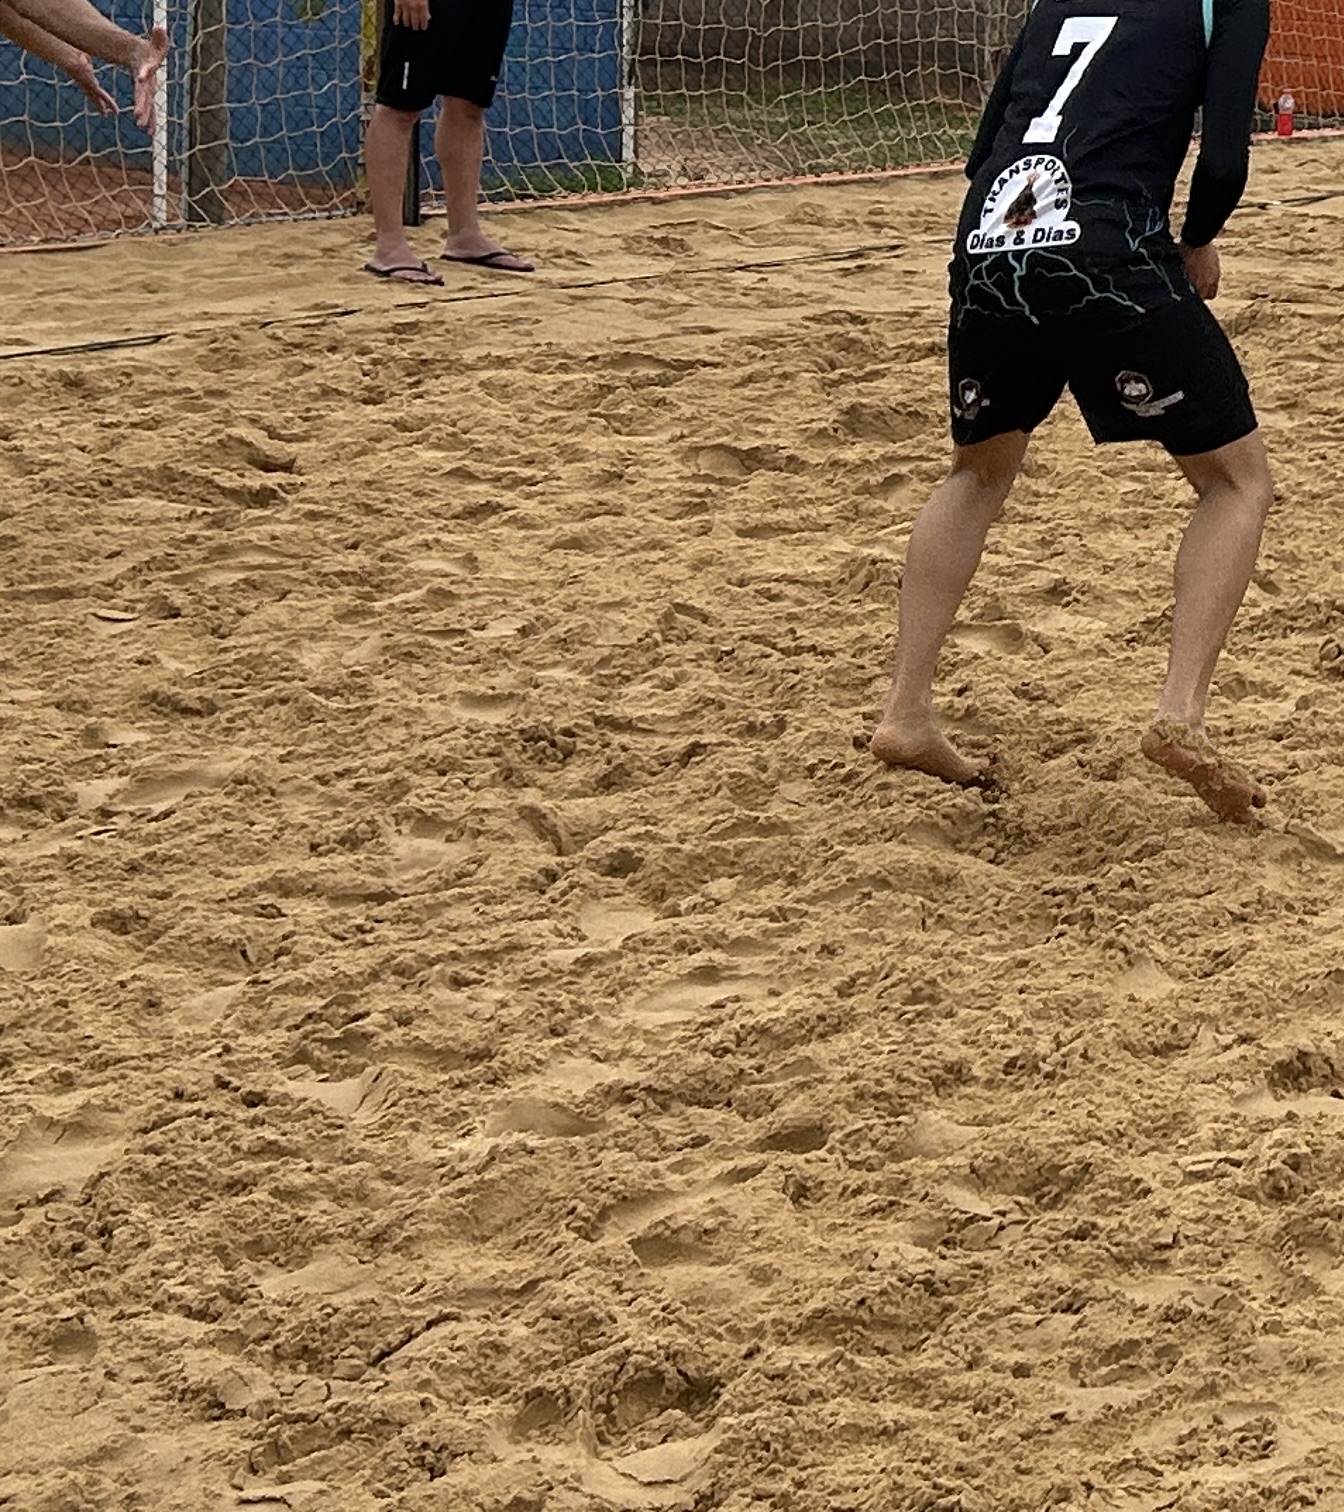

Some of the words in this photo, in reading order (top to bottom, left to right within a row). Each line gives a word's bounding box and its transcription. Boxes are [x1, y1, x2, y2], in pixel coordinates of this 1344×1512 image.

[1022, 16, 1119, 145] 7
[969, 232, 1006, 250] Dias
[1013, 229, 1026, 246] &
[1031, 227, 1077, 244] Dias
